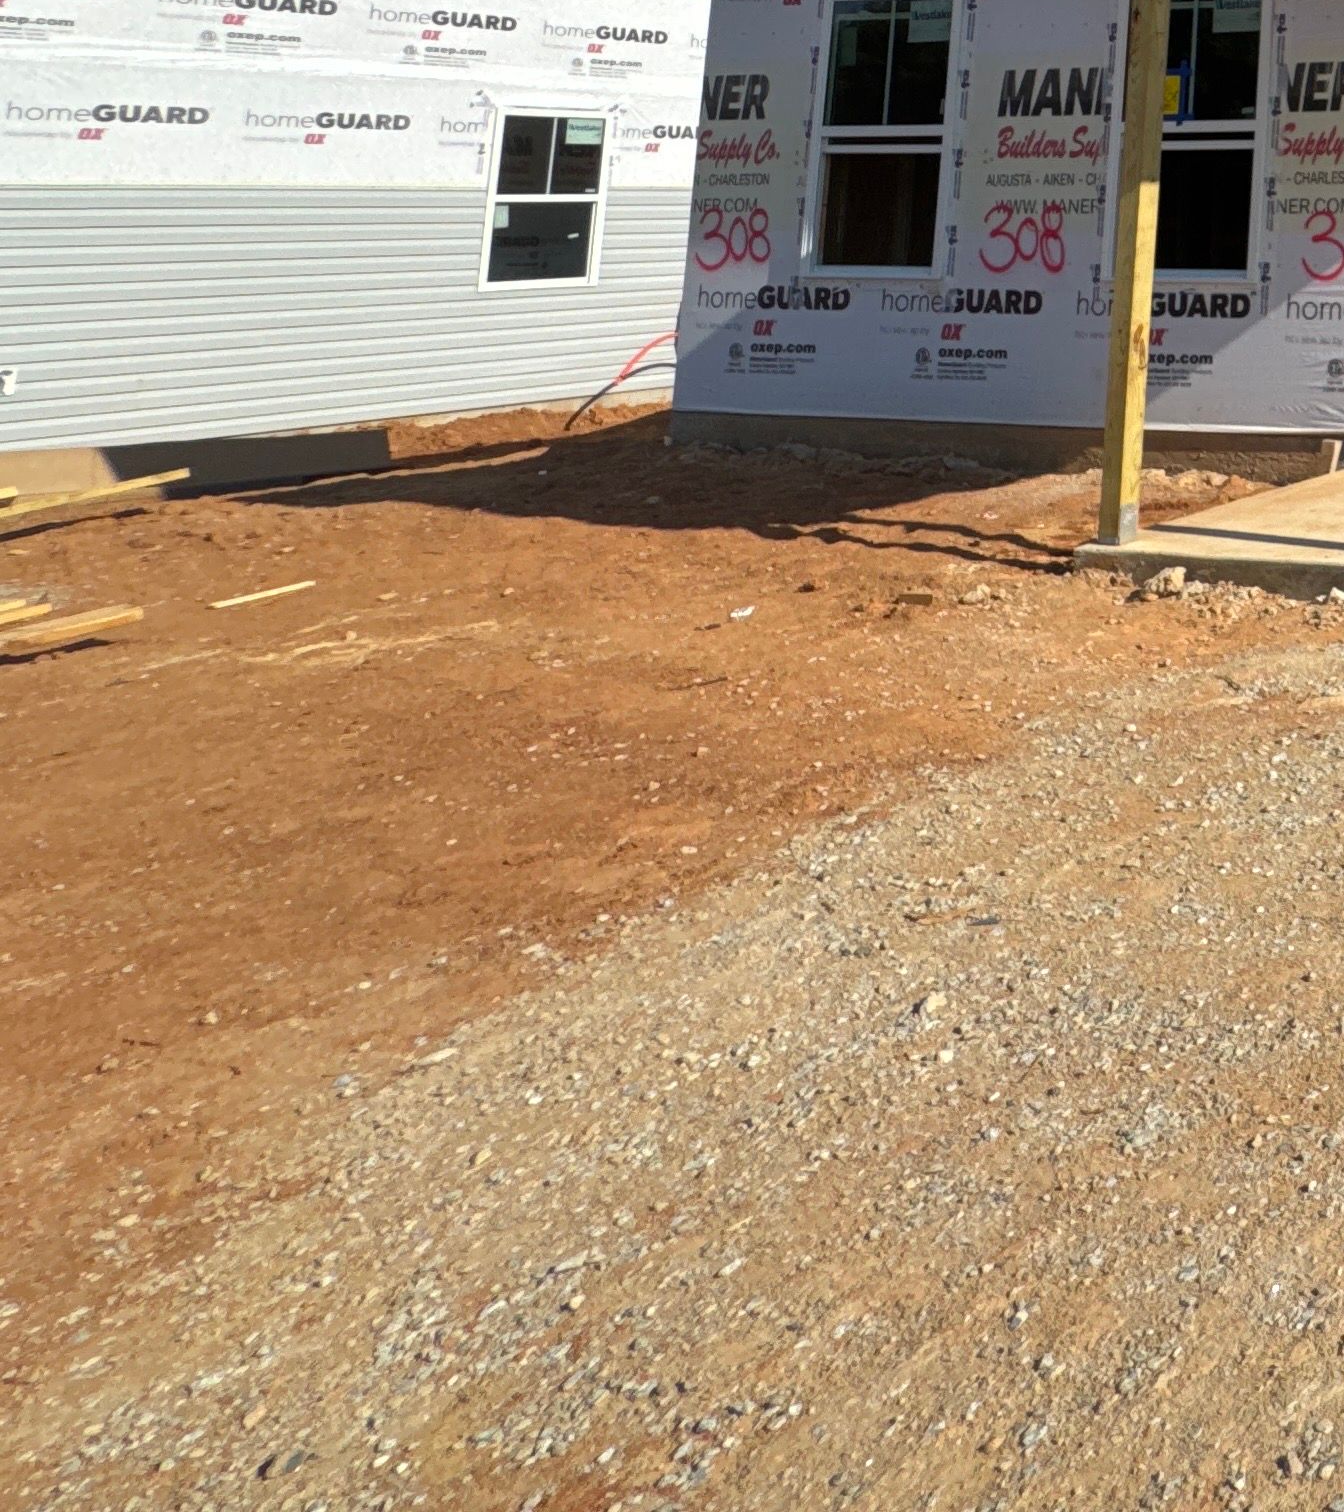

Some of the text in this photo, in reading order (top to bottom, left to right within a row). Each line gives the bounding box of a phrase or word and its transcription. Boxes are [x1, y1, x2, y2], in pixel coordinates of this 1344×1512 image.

[222, 13, 250, 26] OX
[369, 2, 518, 32] homeGUARD
[421, 29, 443, 41] OX
[543, 21, 669, 45] homeGUARD
[6, 101, 210, 126] homeGUARD
[244, 109, 412, 131] homeGUARD
[77, 128, 107, 141] OX
[303, 133, 327, 145] OX
[997, 125, 1066, 160] Builders
[699, 128, 780, 169] Supply Co.
[708, 173, 770, 187] CHARLESTON
[986, 172, 1075, 187] AUGUSTA AIKEN
[695, 207, 772, 272] 308
[979, 203, 1065, 275] 308
[697, 284, 850, 312] homeGUARD
[753, 318, 775, 336] OX
[941, 323, 963, 341] OX
[750, 342, 816, 356] oxep.com
[938, 347, 1008, 361] oxep.com
